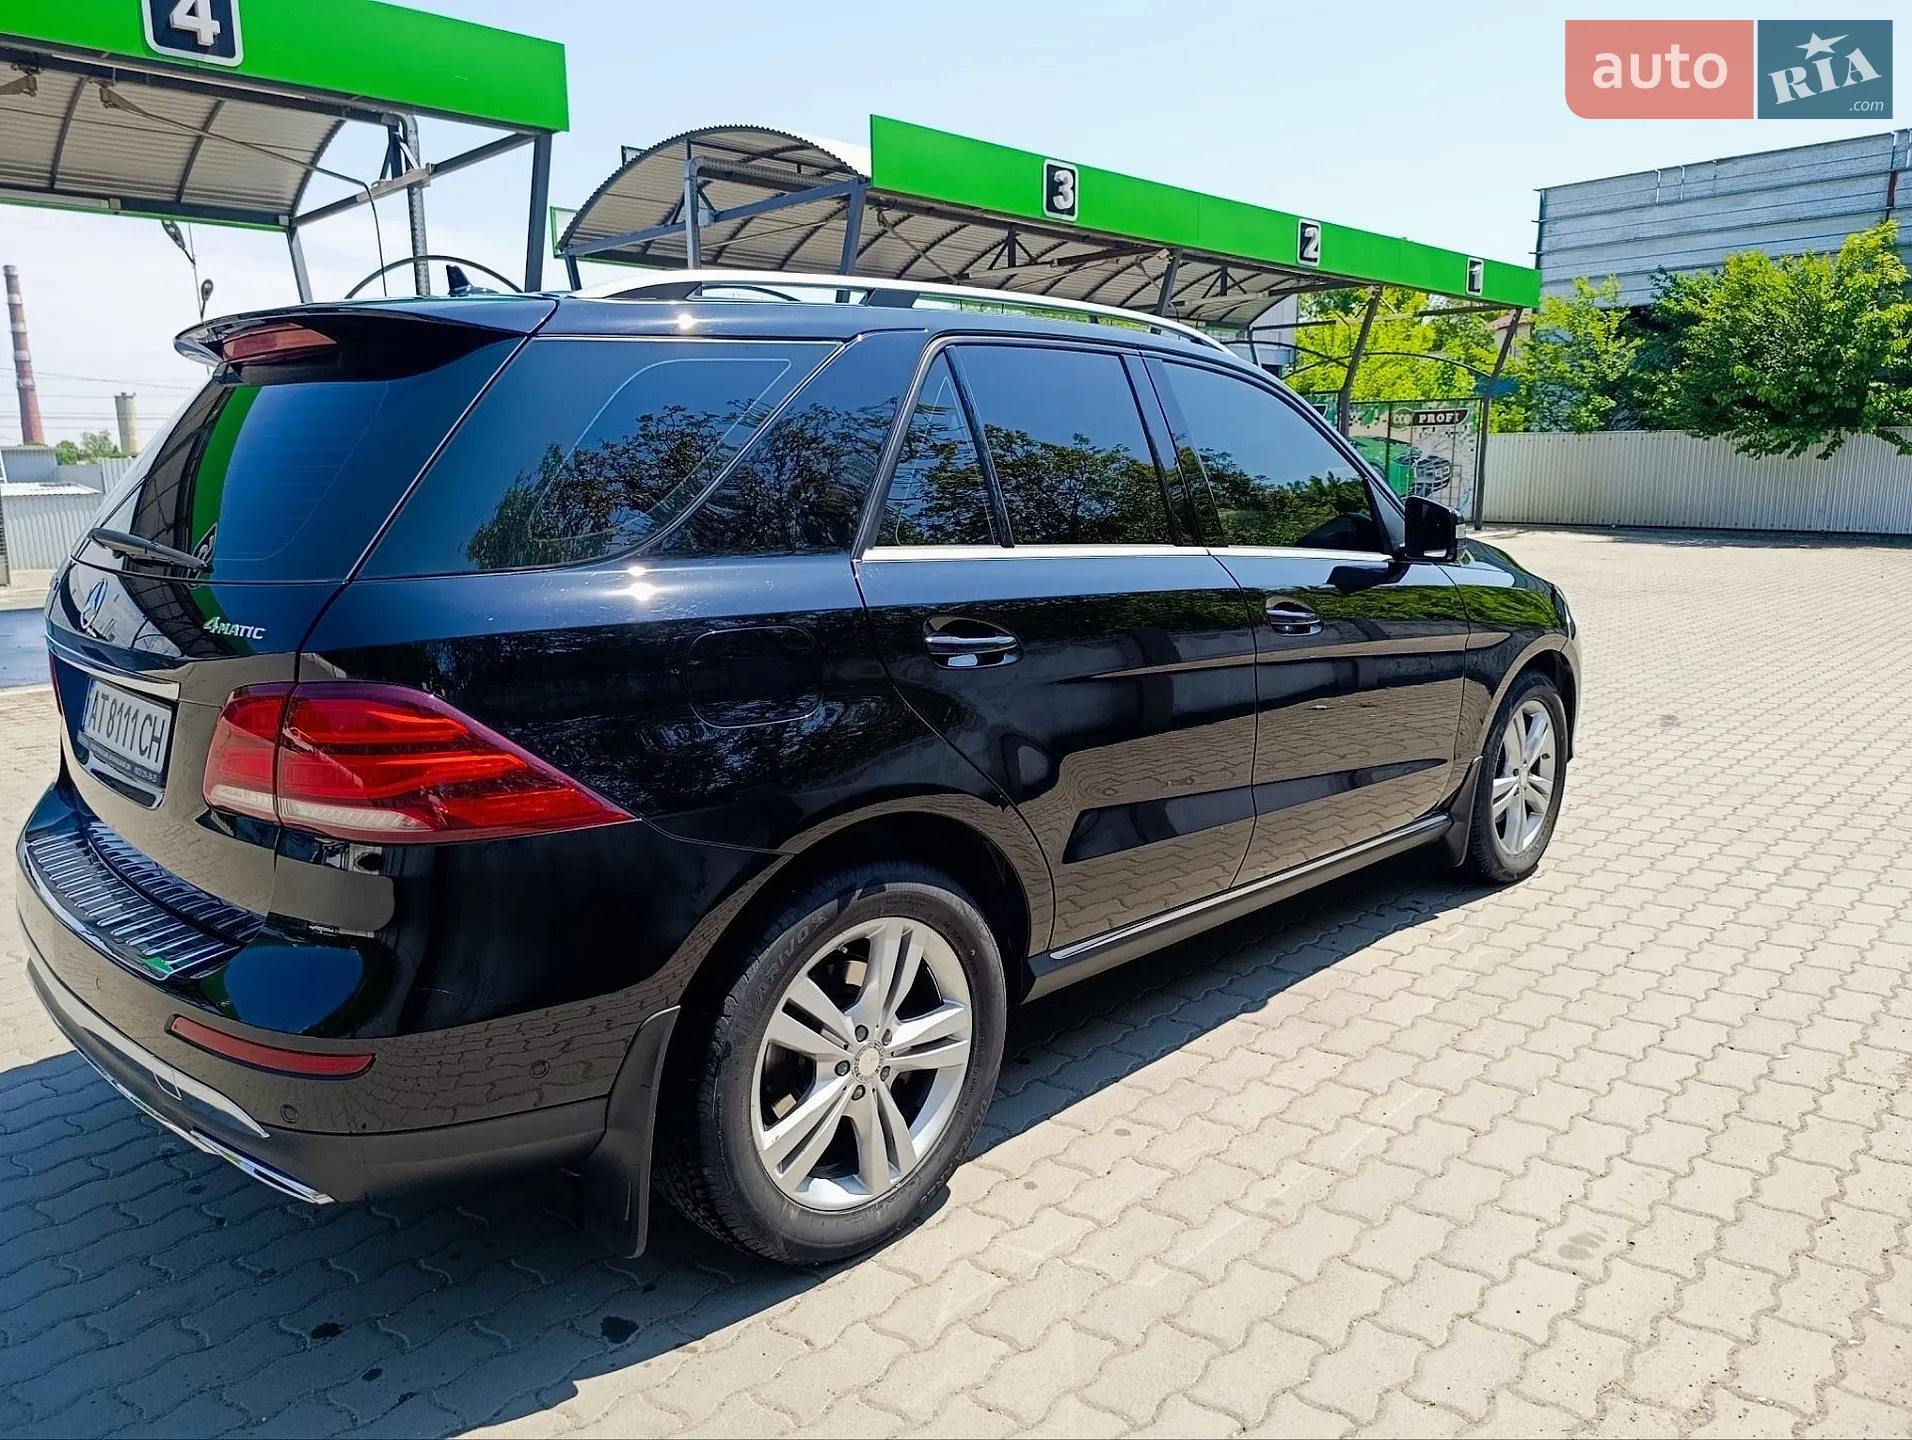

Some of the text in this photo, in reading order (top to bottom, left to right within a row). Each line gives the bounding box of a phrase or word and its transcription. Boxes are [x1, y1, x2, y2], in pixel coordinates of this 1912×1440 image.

[169, 0, 221, 47] 4
[1053, 169, 1074, 210] 3
[1303, 227, 1319, 259] 2
[1468, 263, 1481, 292] 1
[1418, 412, 1460, 424] PROFI
[203, 616, 266, 639] 4MATIC
